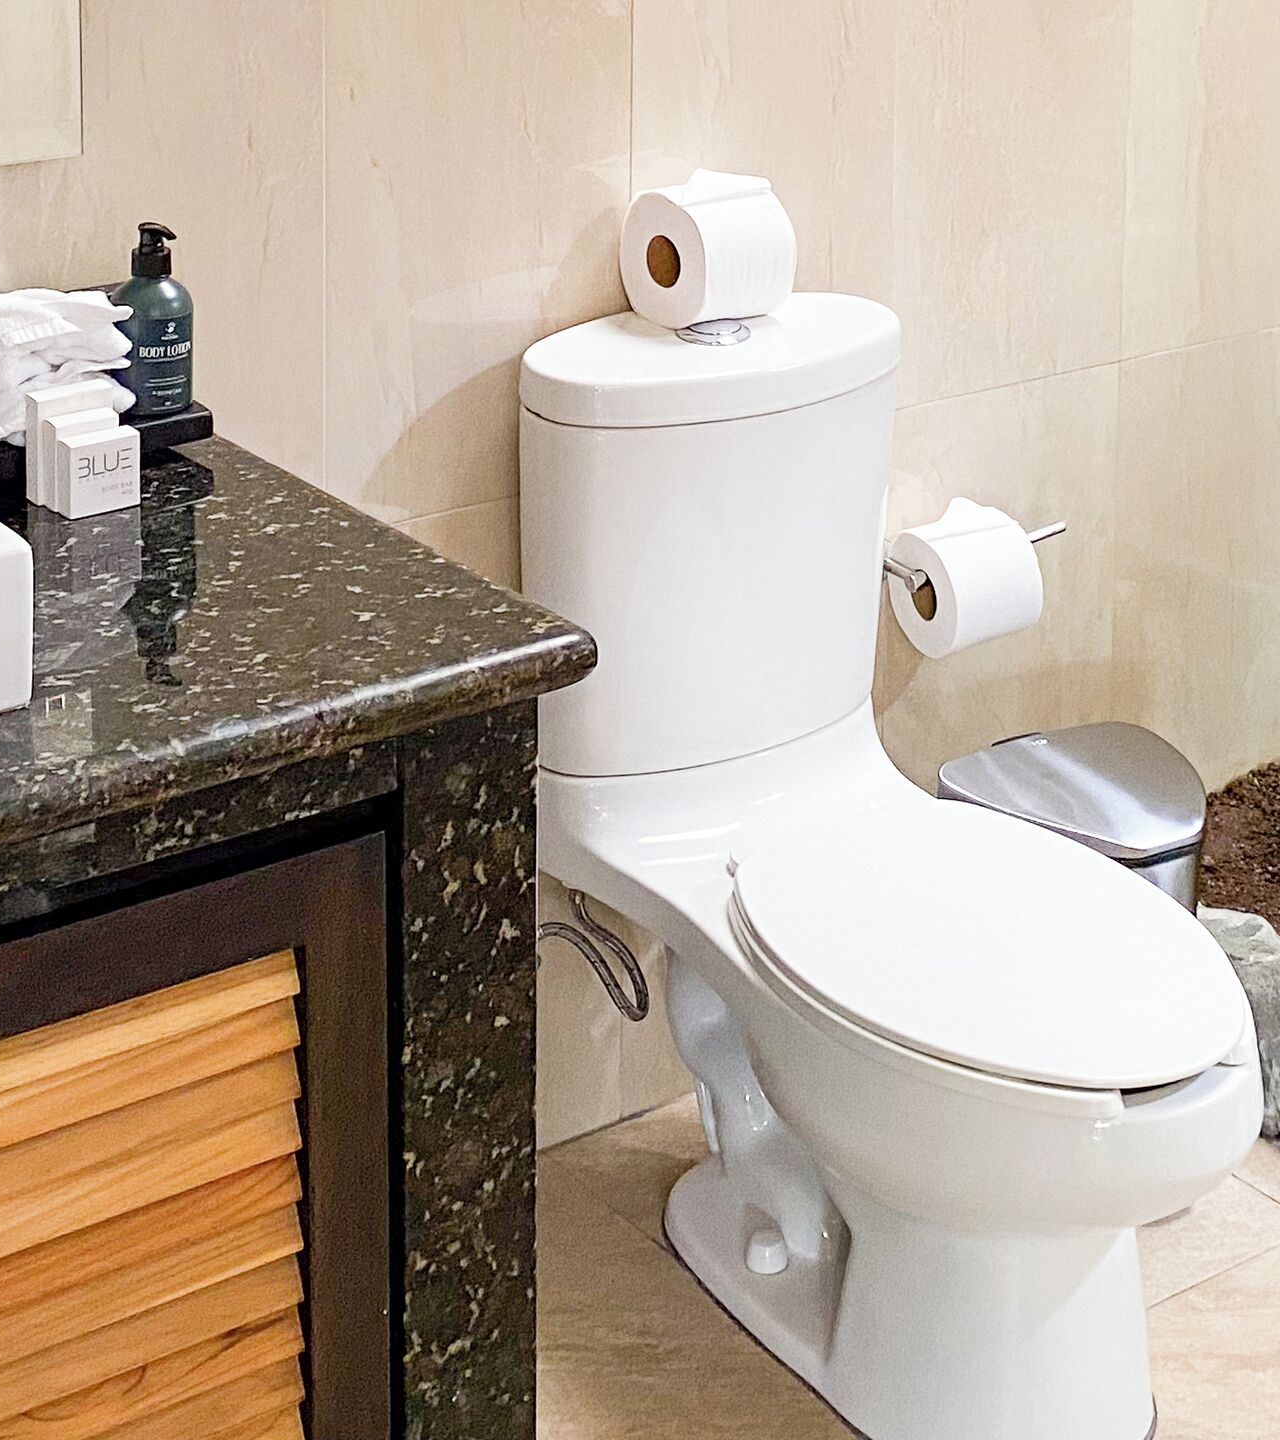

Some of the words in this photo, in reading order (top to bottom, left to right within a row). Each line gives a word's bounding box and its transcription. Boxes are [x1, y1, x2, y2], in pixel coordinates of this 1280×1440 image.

[139, 346, 165, 358] BODY
[167, 341, 191, 356] LOTION
[78, 447, 133, 479] BLUE
